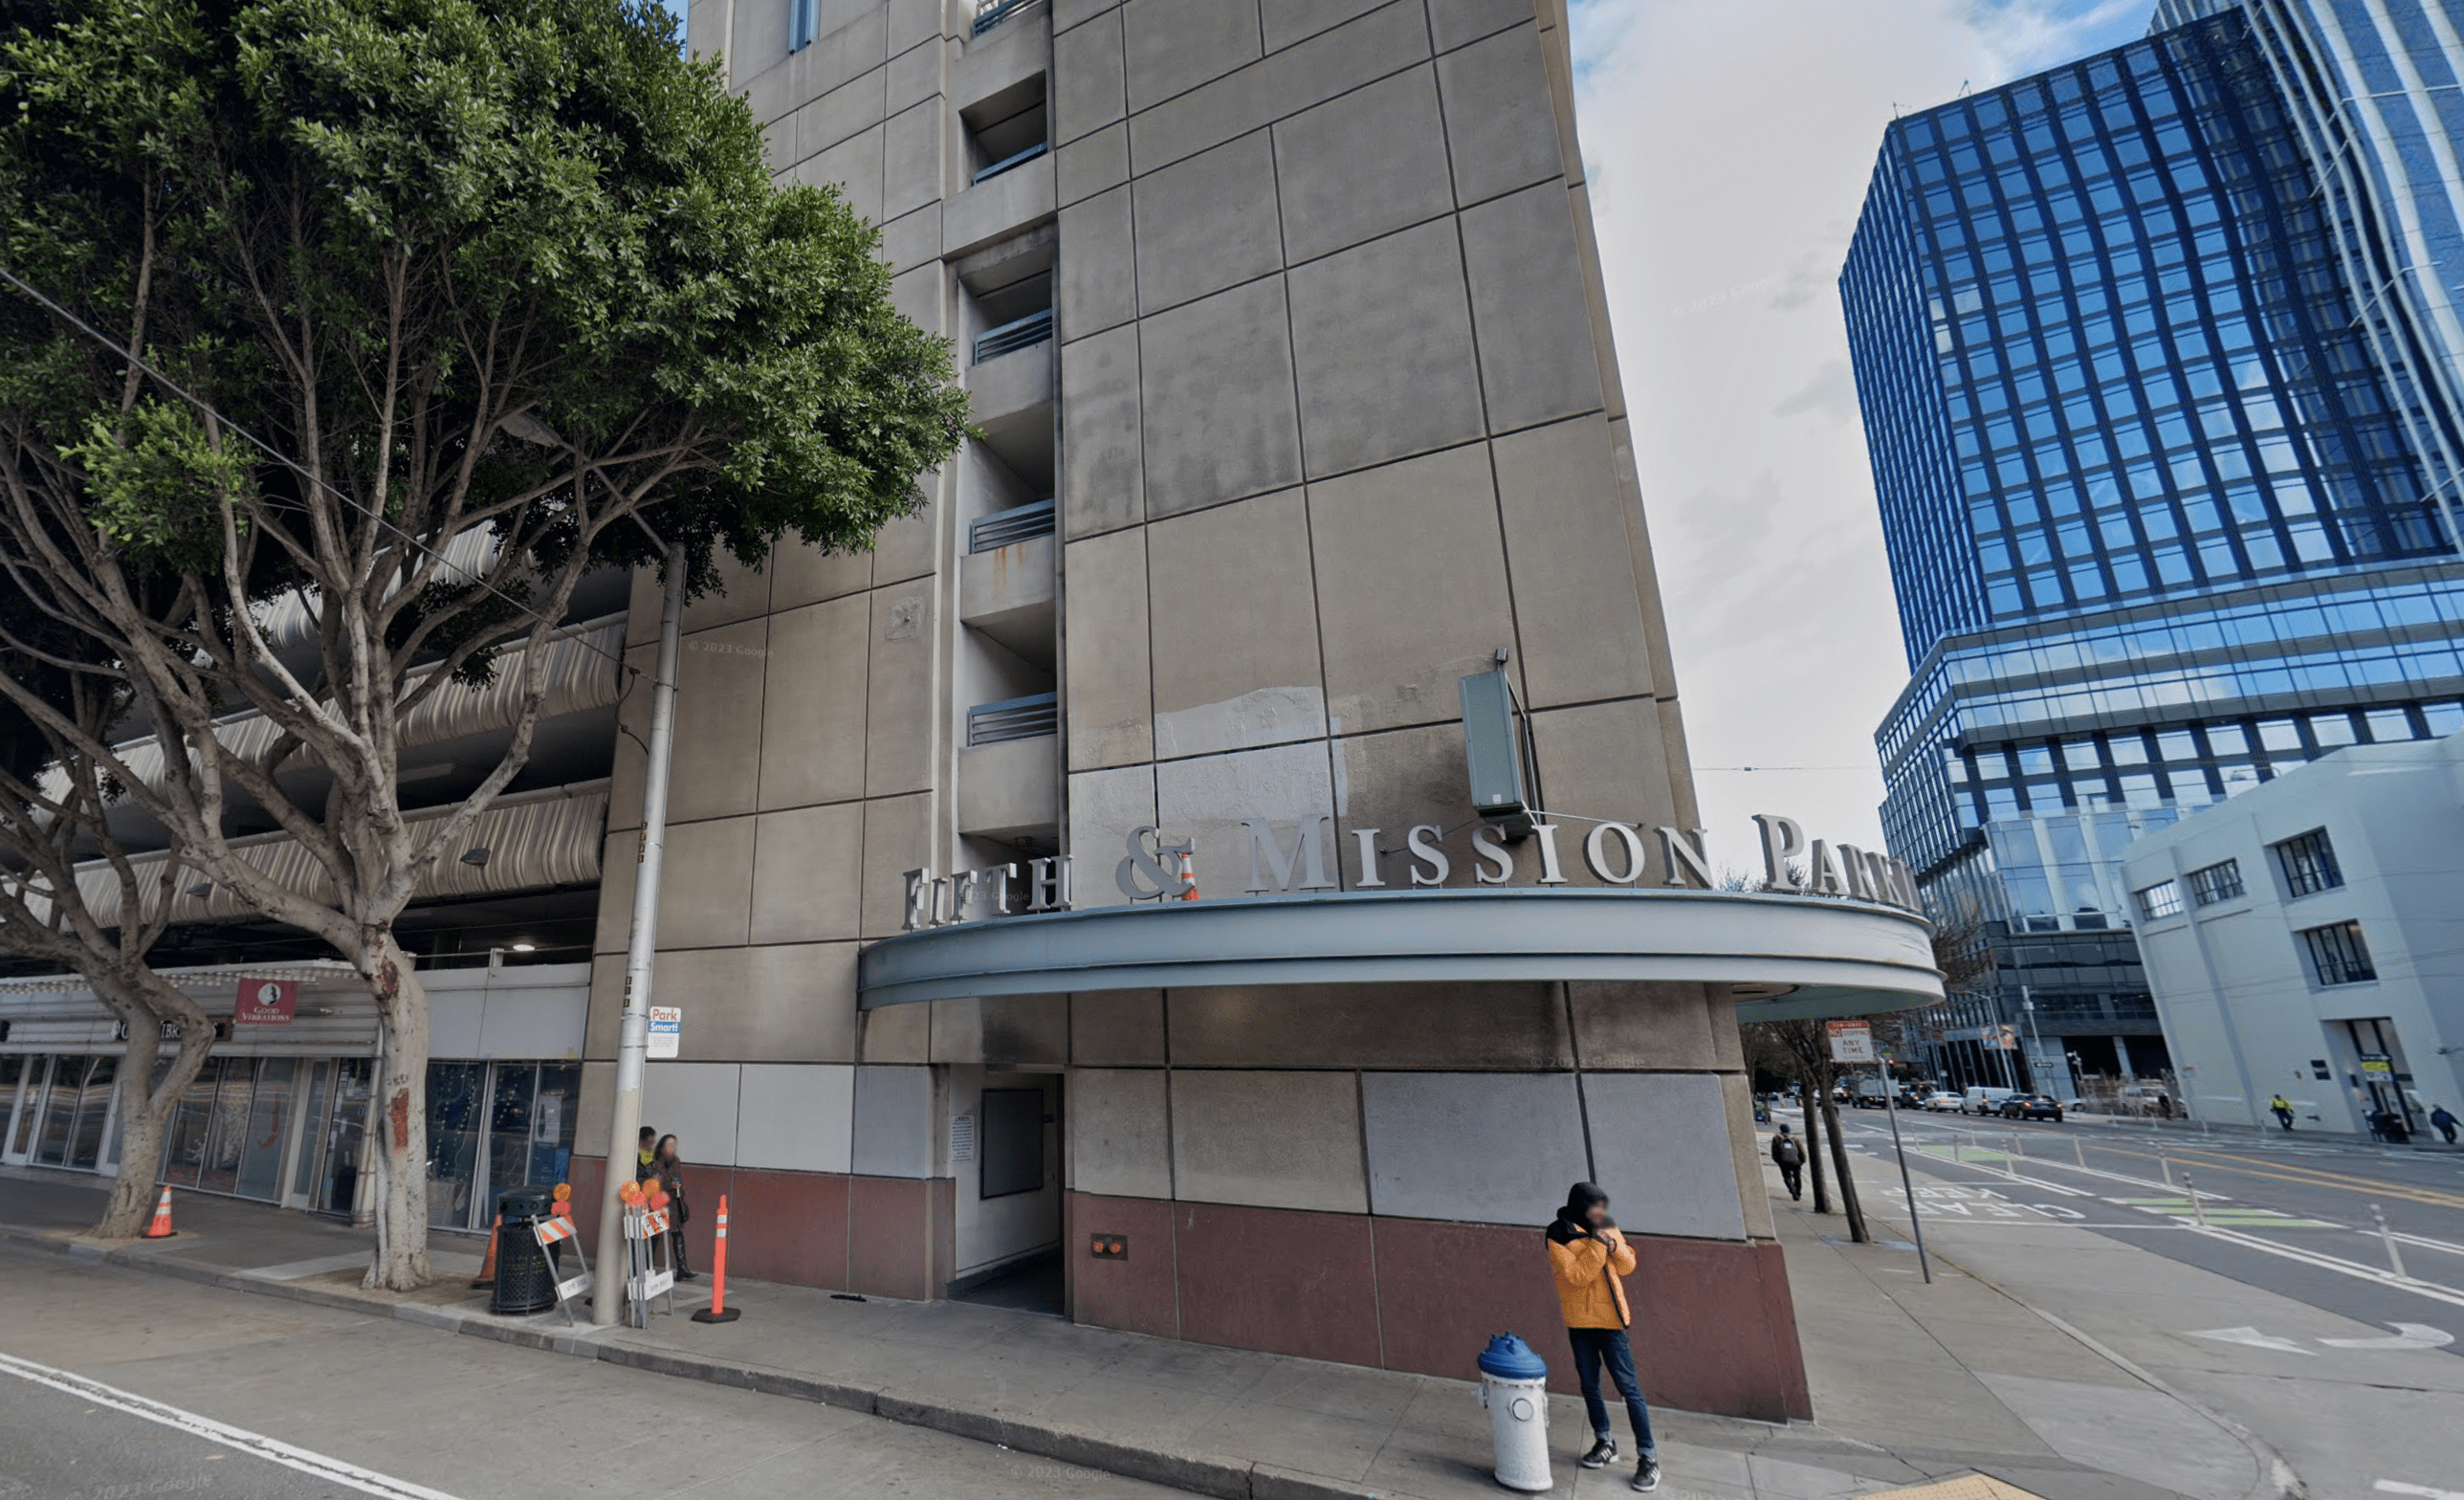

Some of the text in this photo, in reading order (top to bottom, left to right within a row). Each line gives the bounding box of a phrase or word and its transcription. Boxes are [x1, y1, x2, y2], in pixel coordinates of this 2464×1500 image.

[901, 854, 1074, 931] FIFTH
[1115, 826, 1195, 900] &
[1241, 813, 1713, 893] MISSION
[652, 1008, 677, 1021] Park
[650, 1022, 678, 1032] Smart!
[1889, 1200, 2087, 1219] CLEAR
